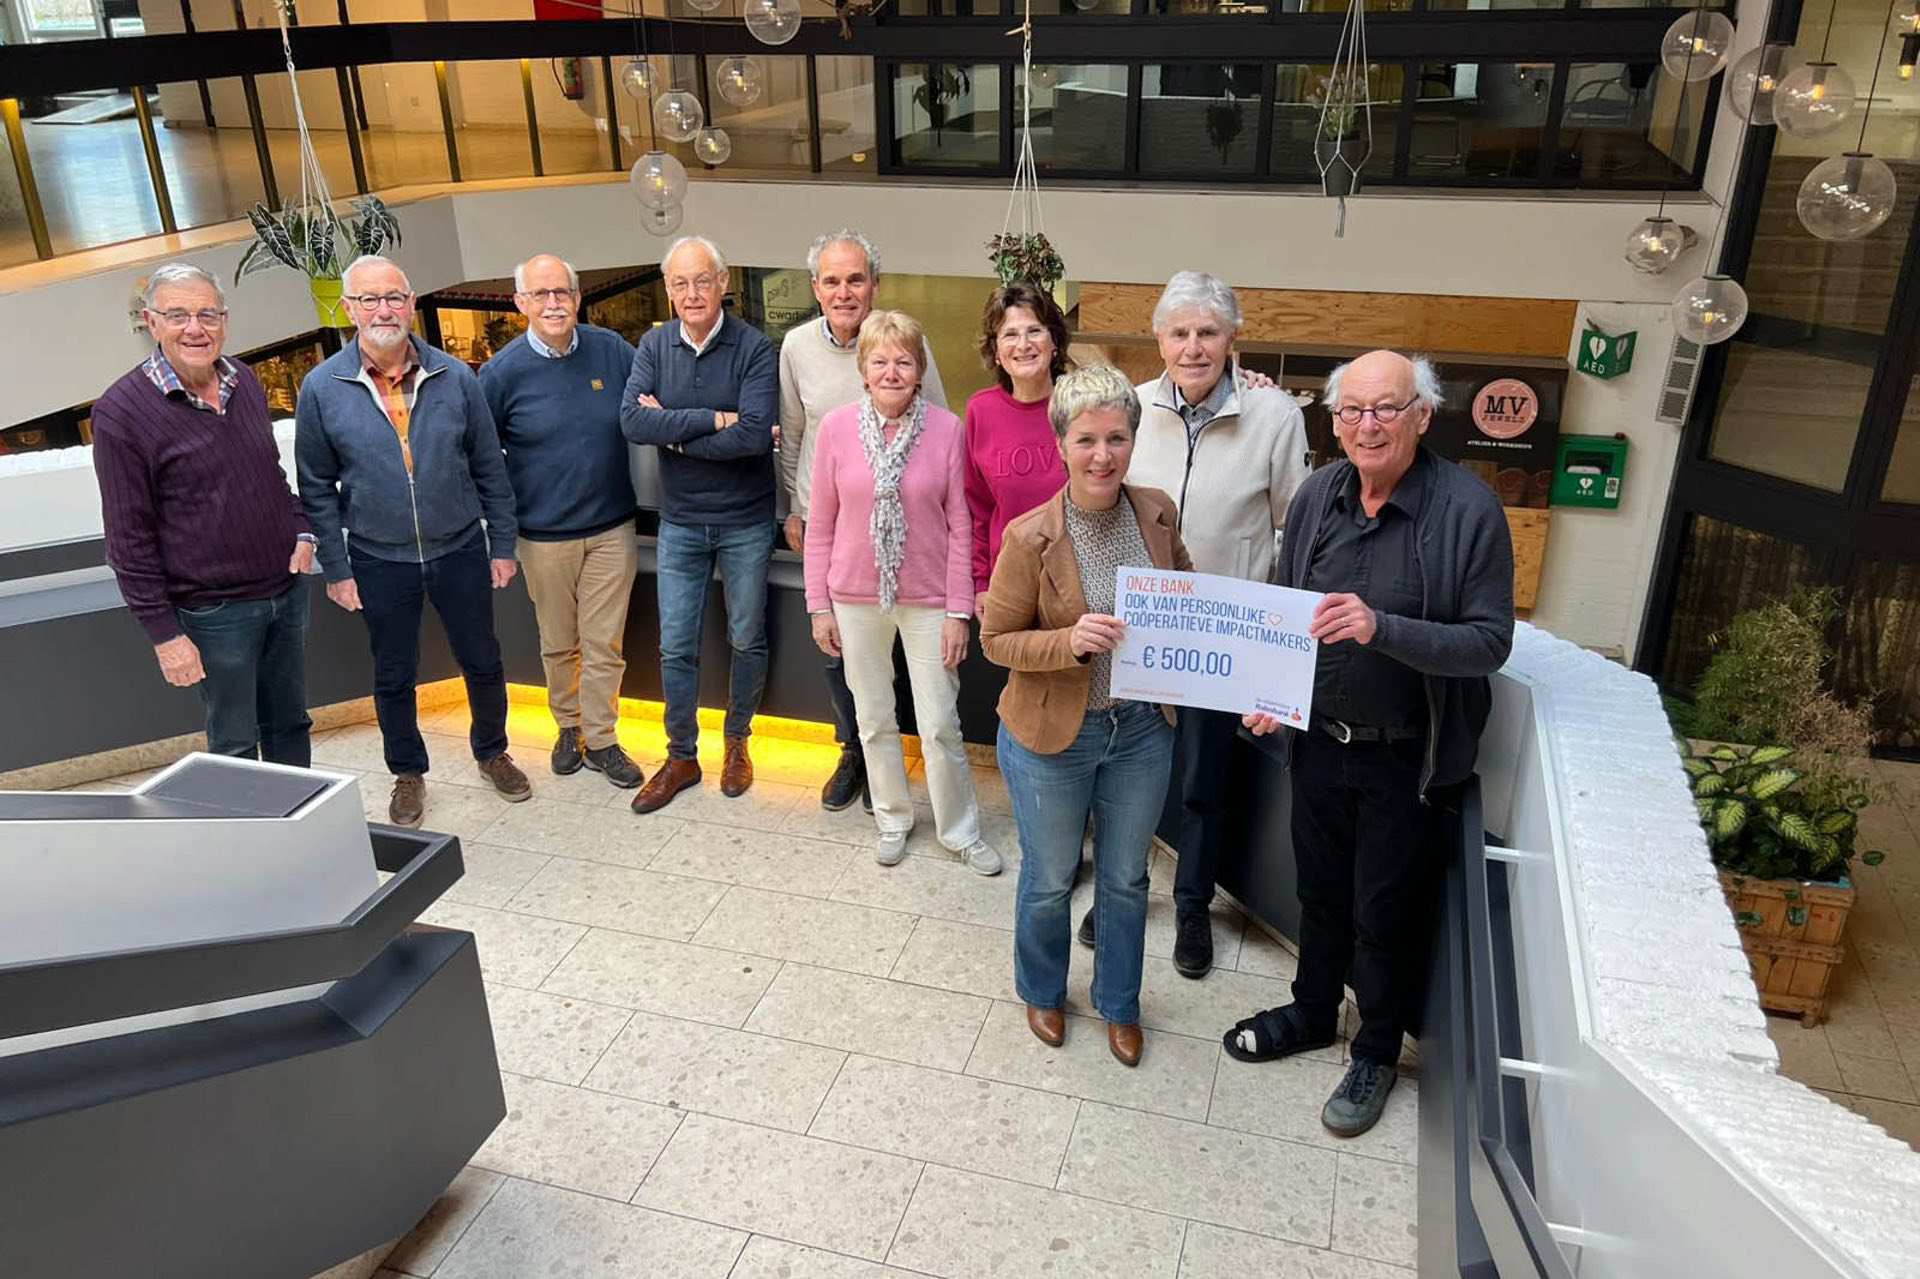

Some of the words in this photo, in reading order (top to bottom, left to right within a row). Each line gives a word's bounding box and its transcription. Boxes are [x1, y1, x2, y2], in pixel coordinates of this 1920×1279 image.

[1583, 359, 1605, 374] AED
[1484, 394, 1528, 415] MV
[991, 444, 1057, 478] LOV
[1126, 575, 1157, 592] ONZE
[1161, 577, 1194, 595] BANK
[1125, 593, 1149, 610] OOK
[1153, 594, 1177, 612] VAN
[1180, 597, 1266, 625] PERSOONLIJKE
[1124, 610, 1213, 633] COÖPERATIEVE
[1216, 618, 1312, 653] IMPACTMAKERS
[1143, 645, 1156, 669] €
[1161, 647, 1232, 677] 500,00
